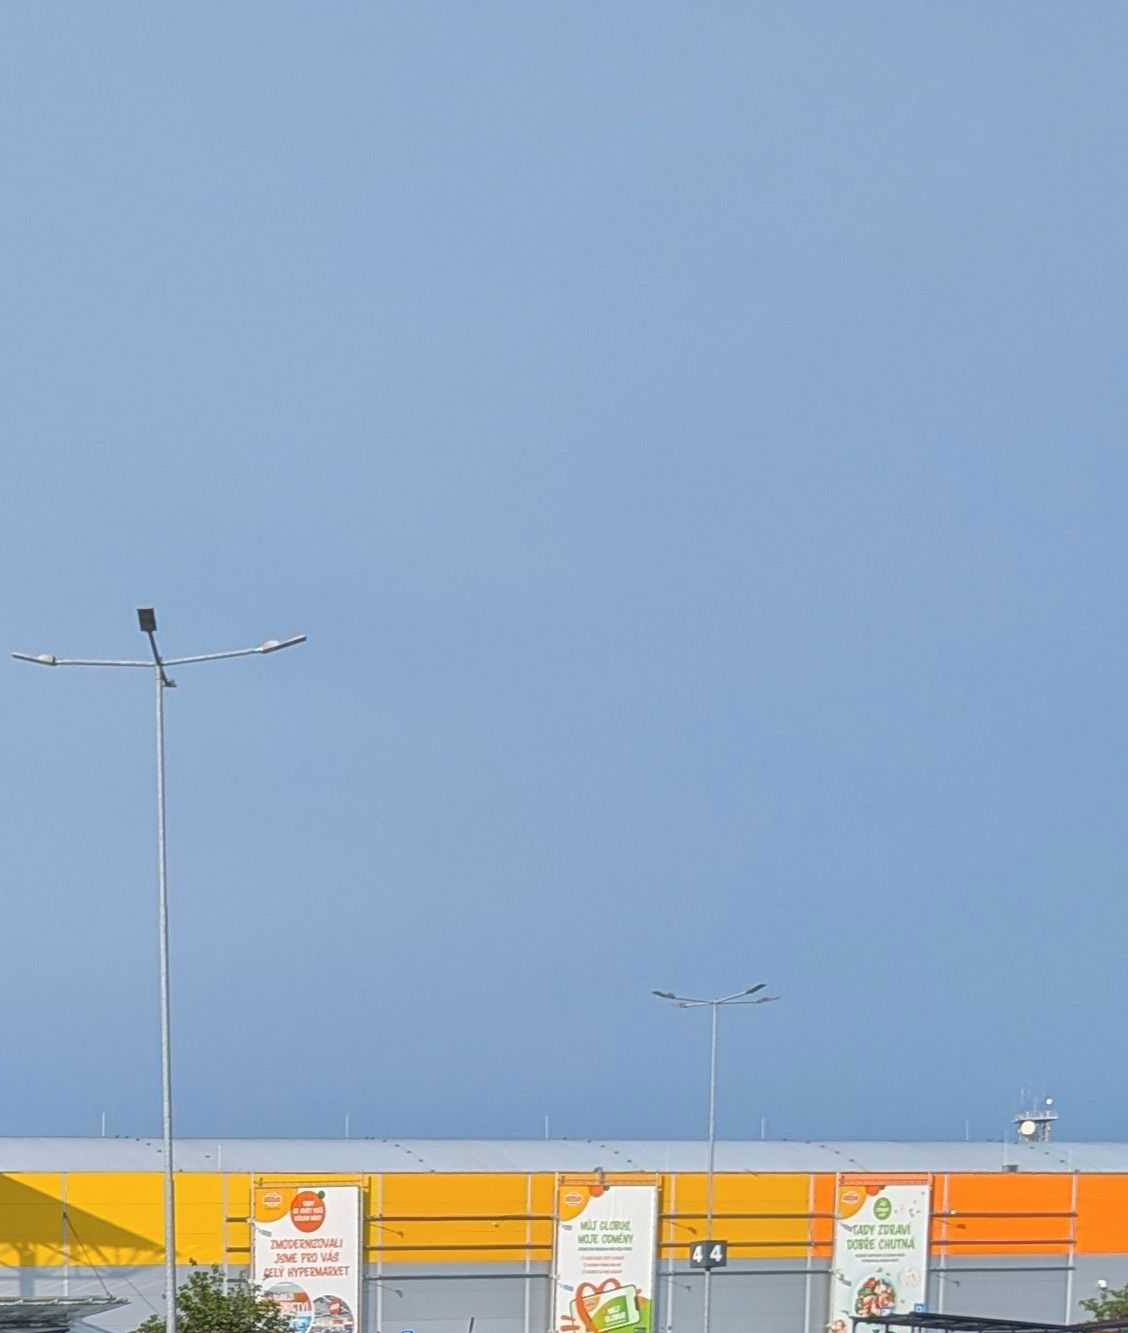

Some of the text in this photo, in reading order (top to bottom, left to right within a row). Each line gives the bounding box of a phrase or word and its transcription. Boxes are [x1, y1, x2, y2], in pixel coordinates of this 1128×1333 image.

[270, 1238, 344, 1250] ZMODERNIZOVALI
[273, 1250, 340, 1264] JSME PRO VÁS
[692, 1245, 703, 1263] 4
[709, 1244, 723, 1262] 4
[287, 1265, 350, 1278] HYPERMARKET
